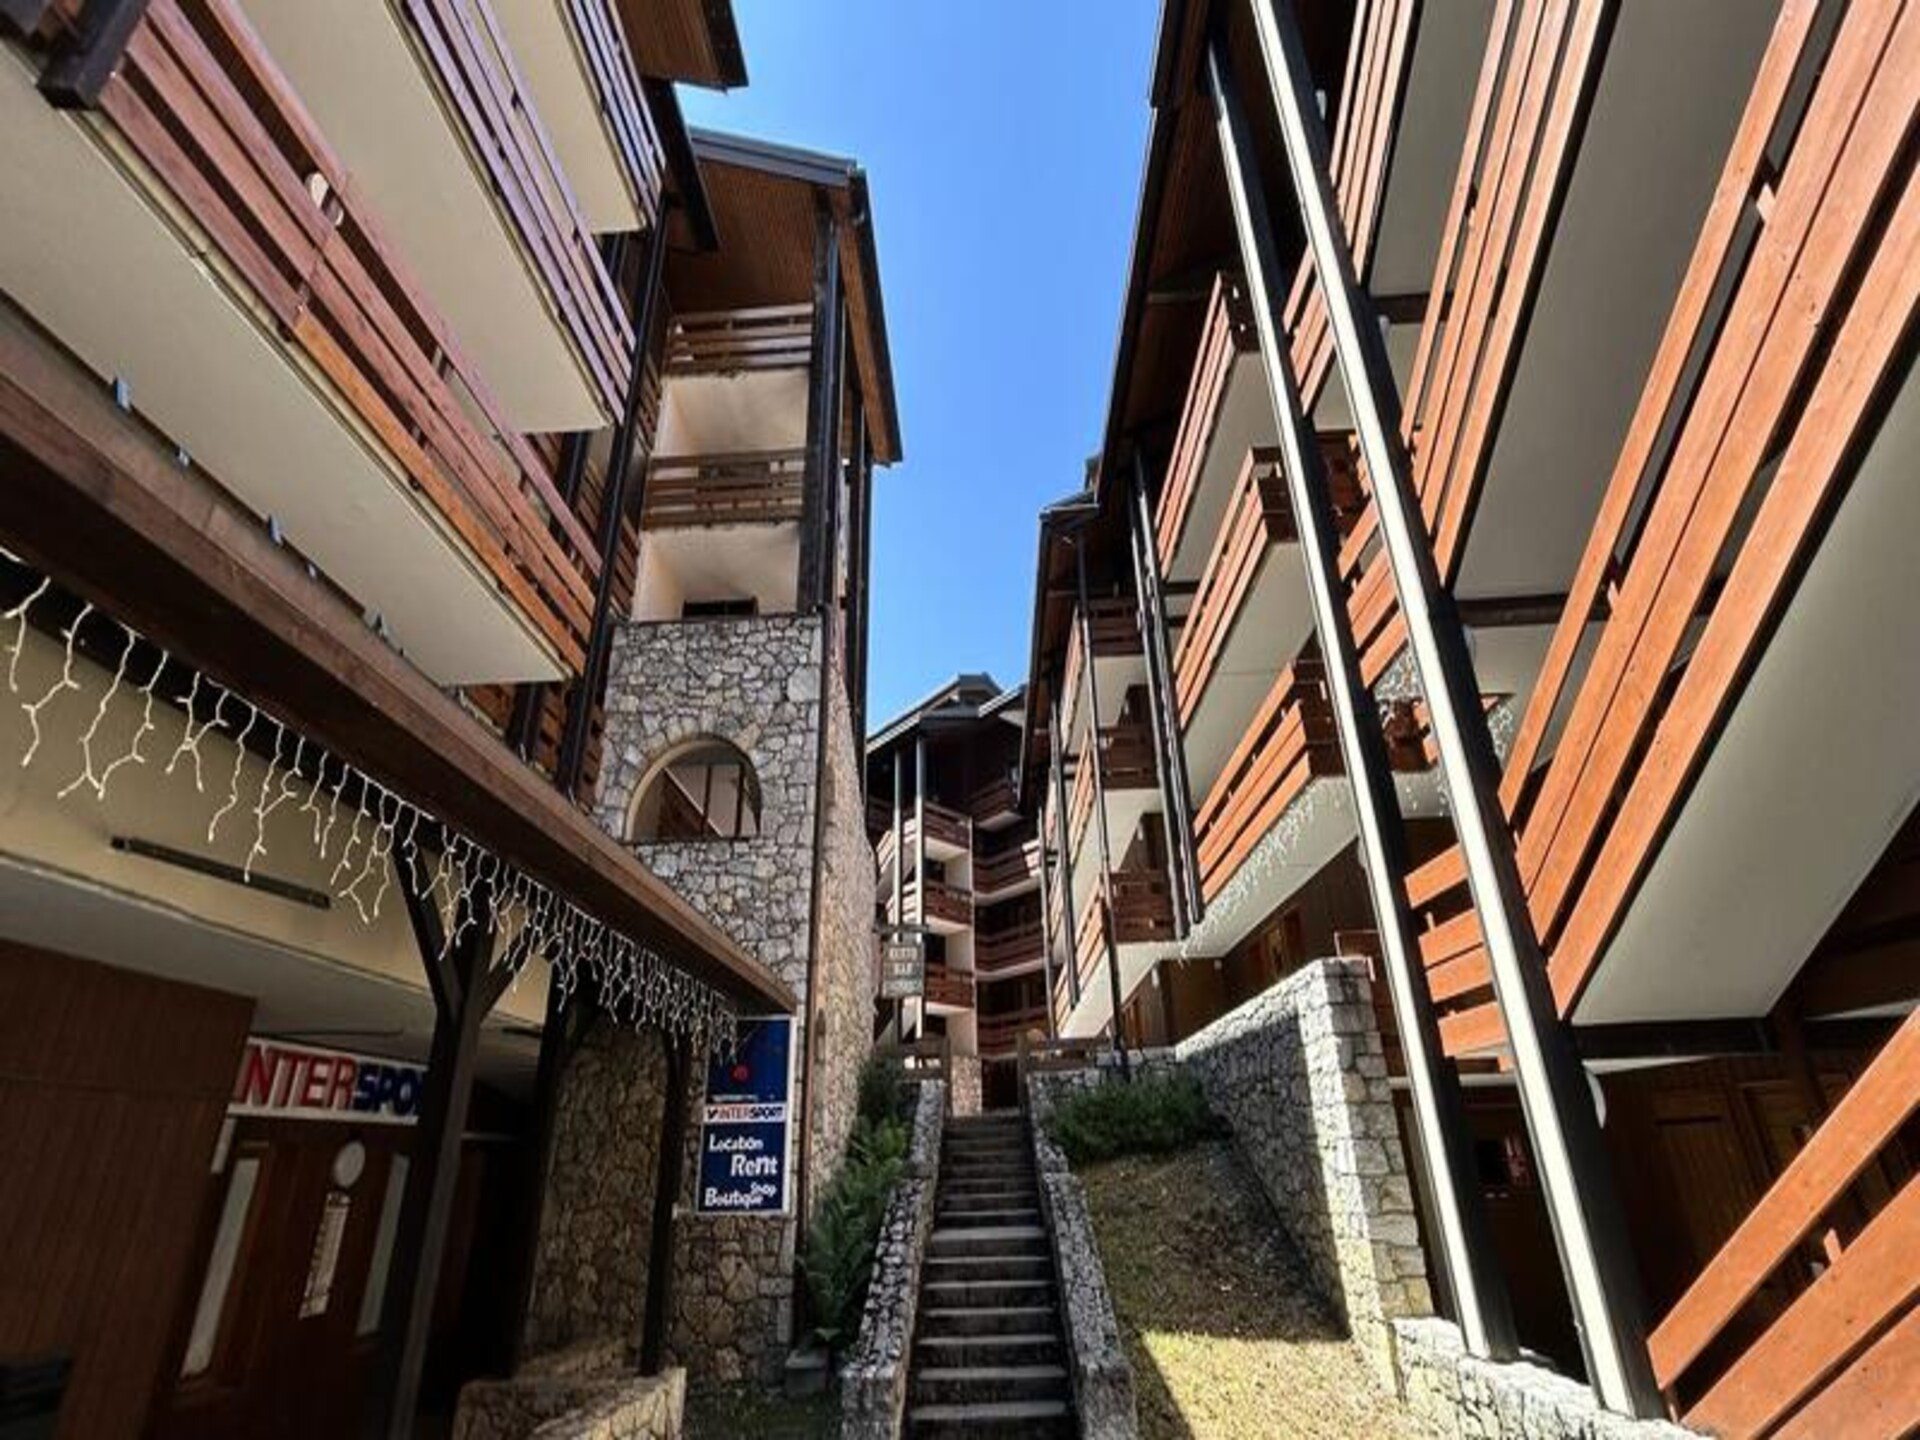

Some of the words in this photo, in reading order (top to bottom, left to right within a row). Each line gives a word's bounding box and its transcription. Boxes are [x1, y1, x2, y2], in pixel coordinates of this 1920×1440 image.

[709, 1134, 764, 1151] Location
[731, 1154, 778, 1177] Rent
[705, 1187, 764, 1208] Boutique
